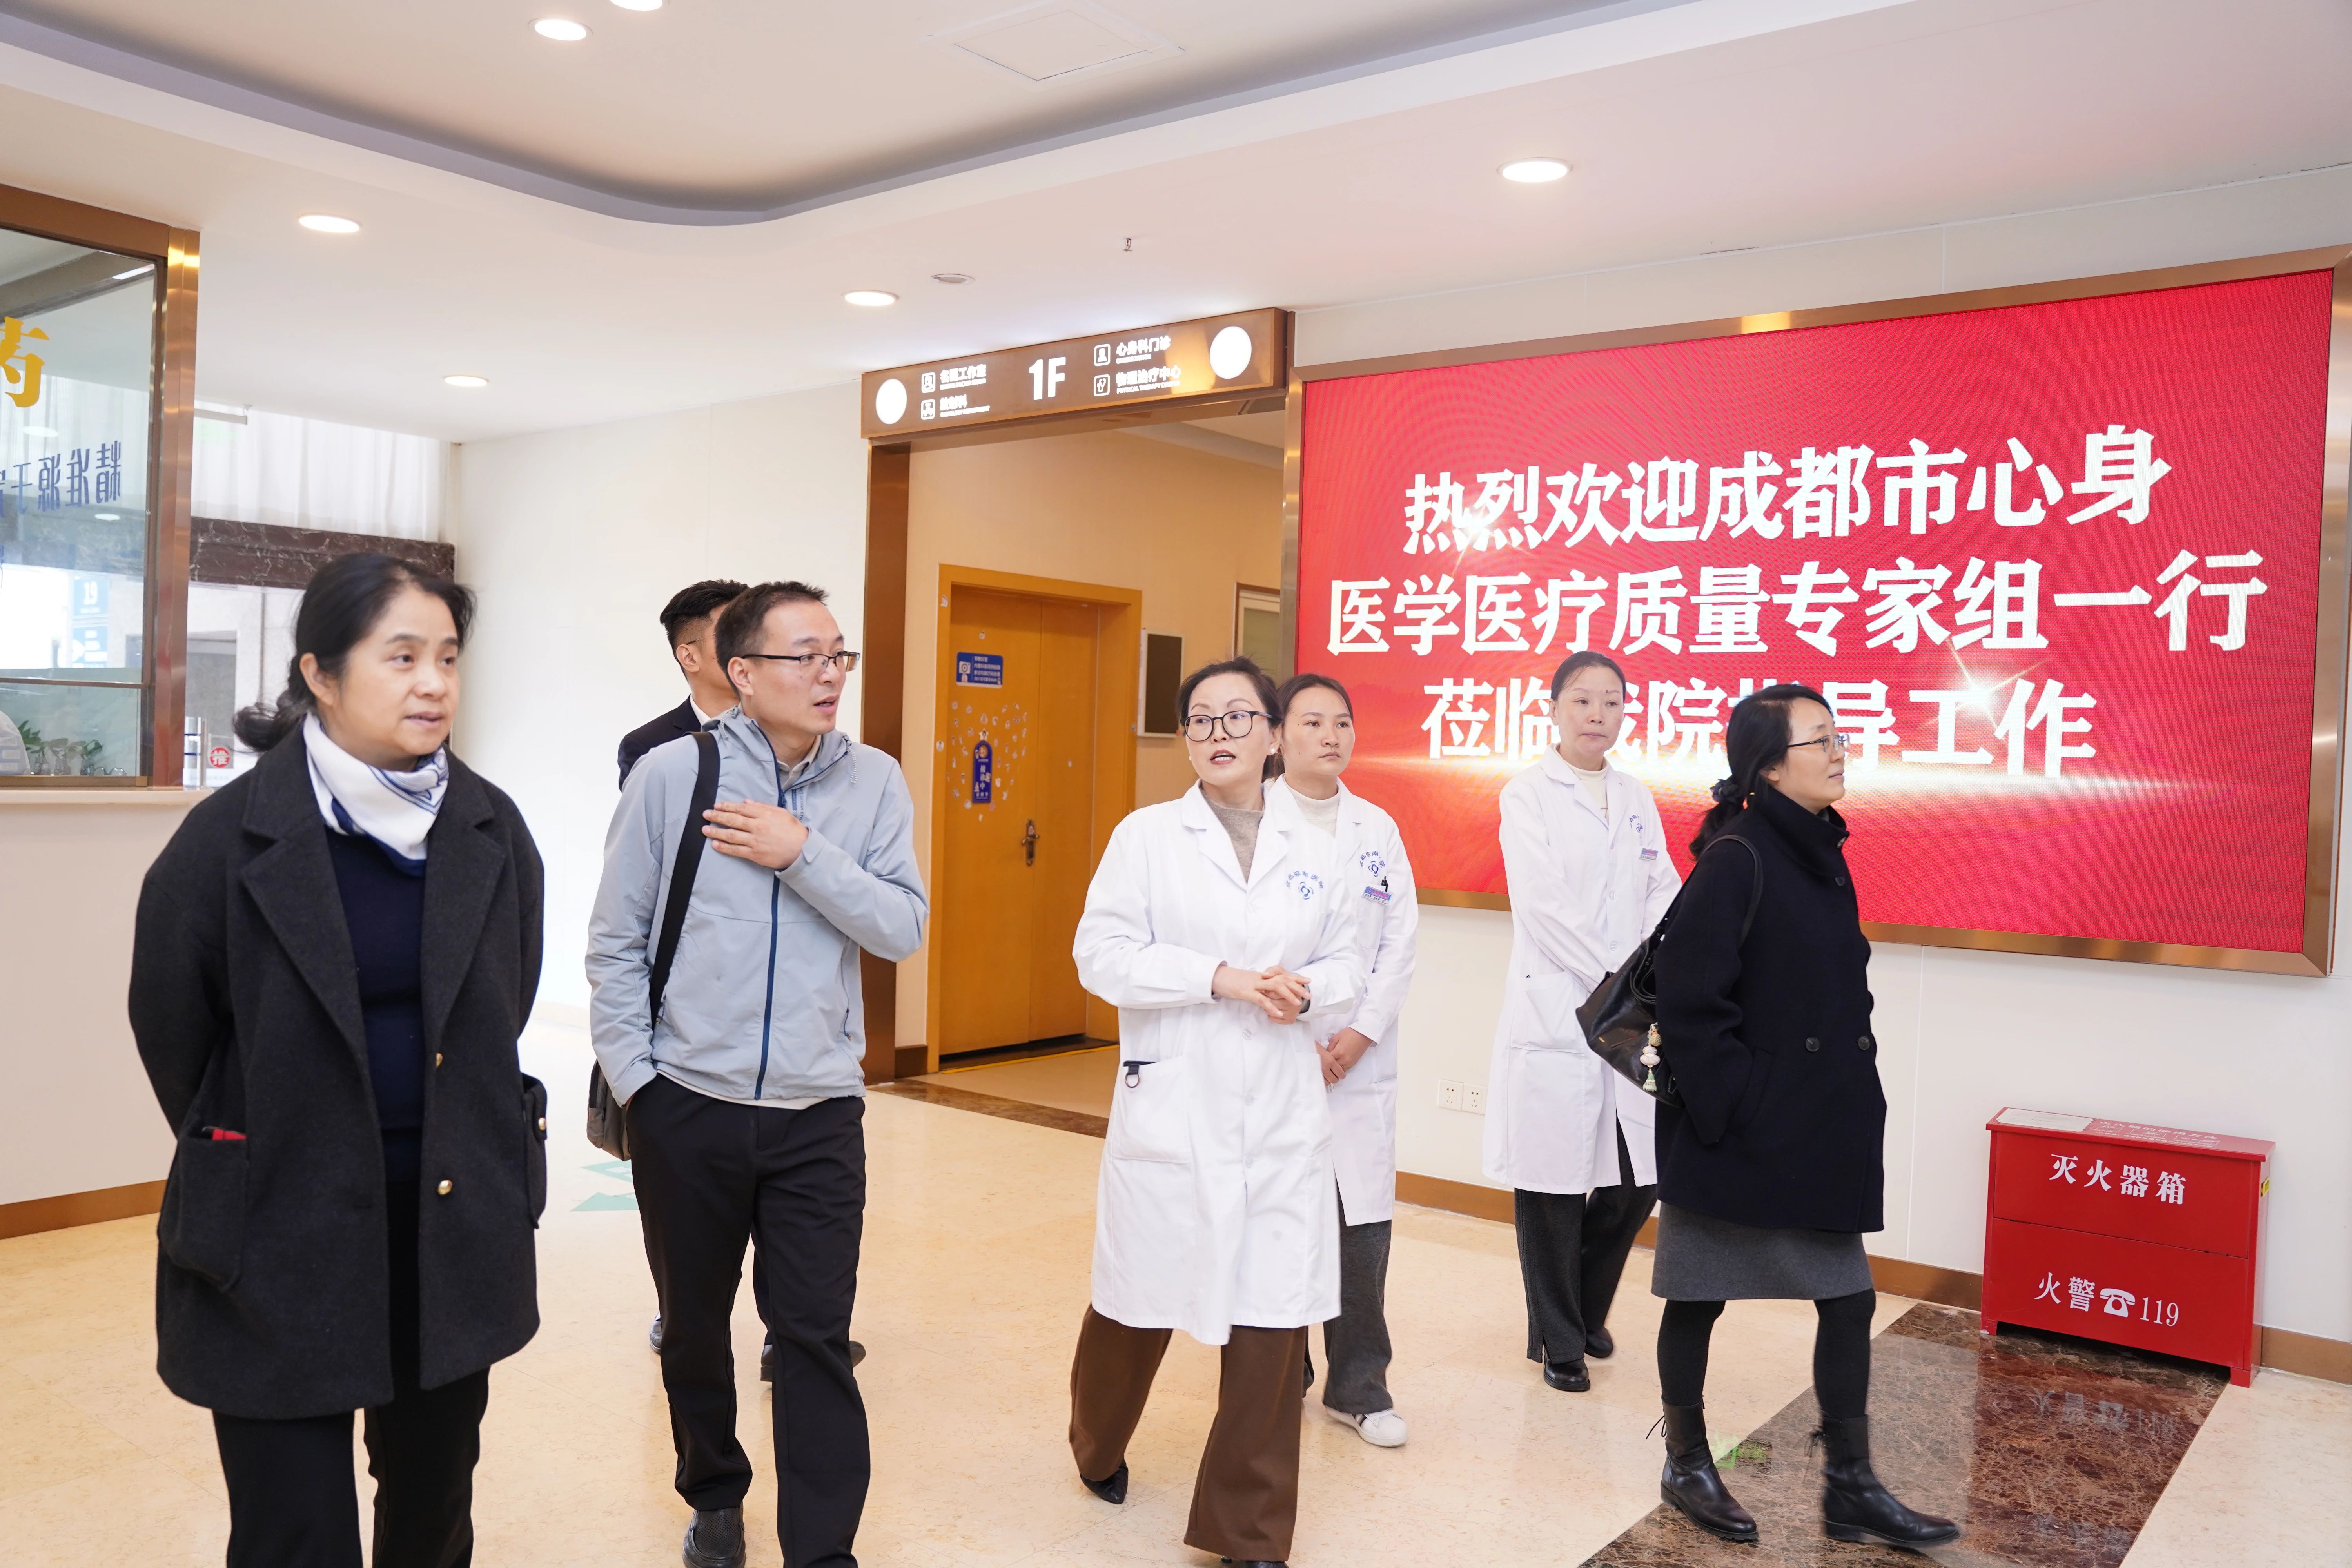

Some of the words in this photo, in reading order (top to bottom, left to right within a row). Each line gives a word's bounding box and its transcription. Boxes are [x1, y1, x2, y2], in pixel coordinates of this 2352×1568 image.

[1029, 357, 1066, 400] 1F
[1403, 424, 2172, 555] 热烈欢迎成都市心身
[1327, 549, 2269, 657] 医学医疗质量专家组一行
[1421, 676, 2098, 778] 莅临院导工作
[2049, 1154, 2186, 1205] 灭火器箱
[2034, 1272, 2096, 1312] 火警
[2140, 1297, 2179, 1327] 119
